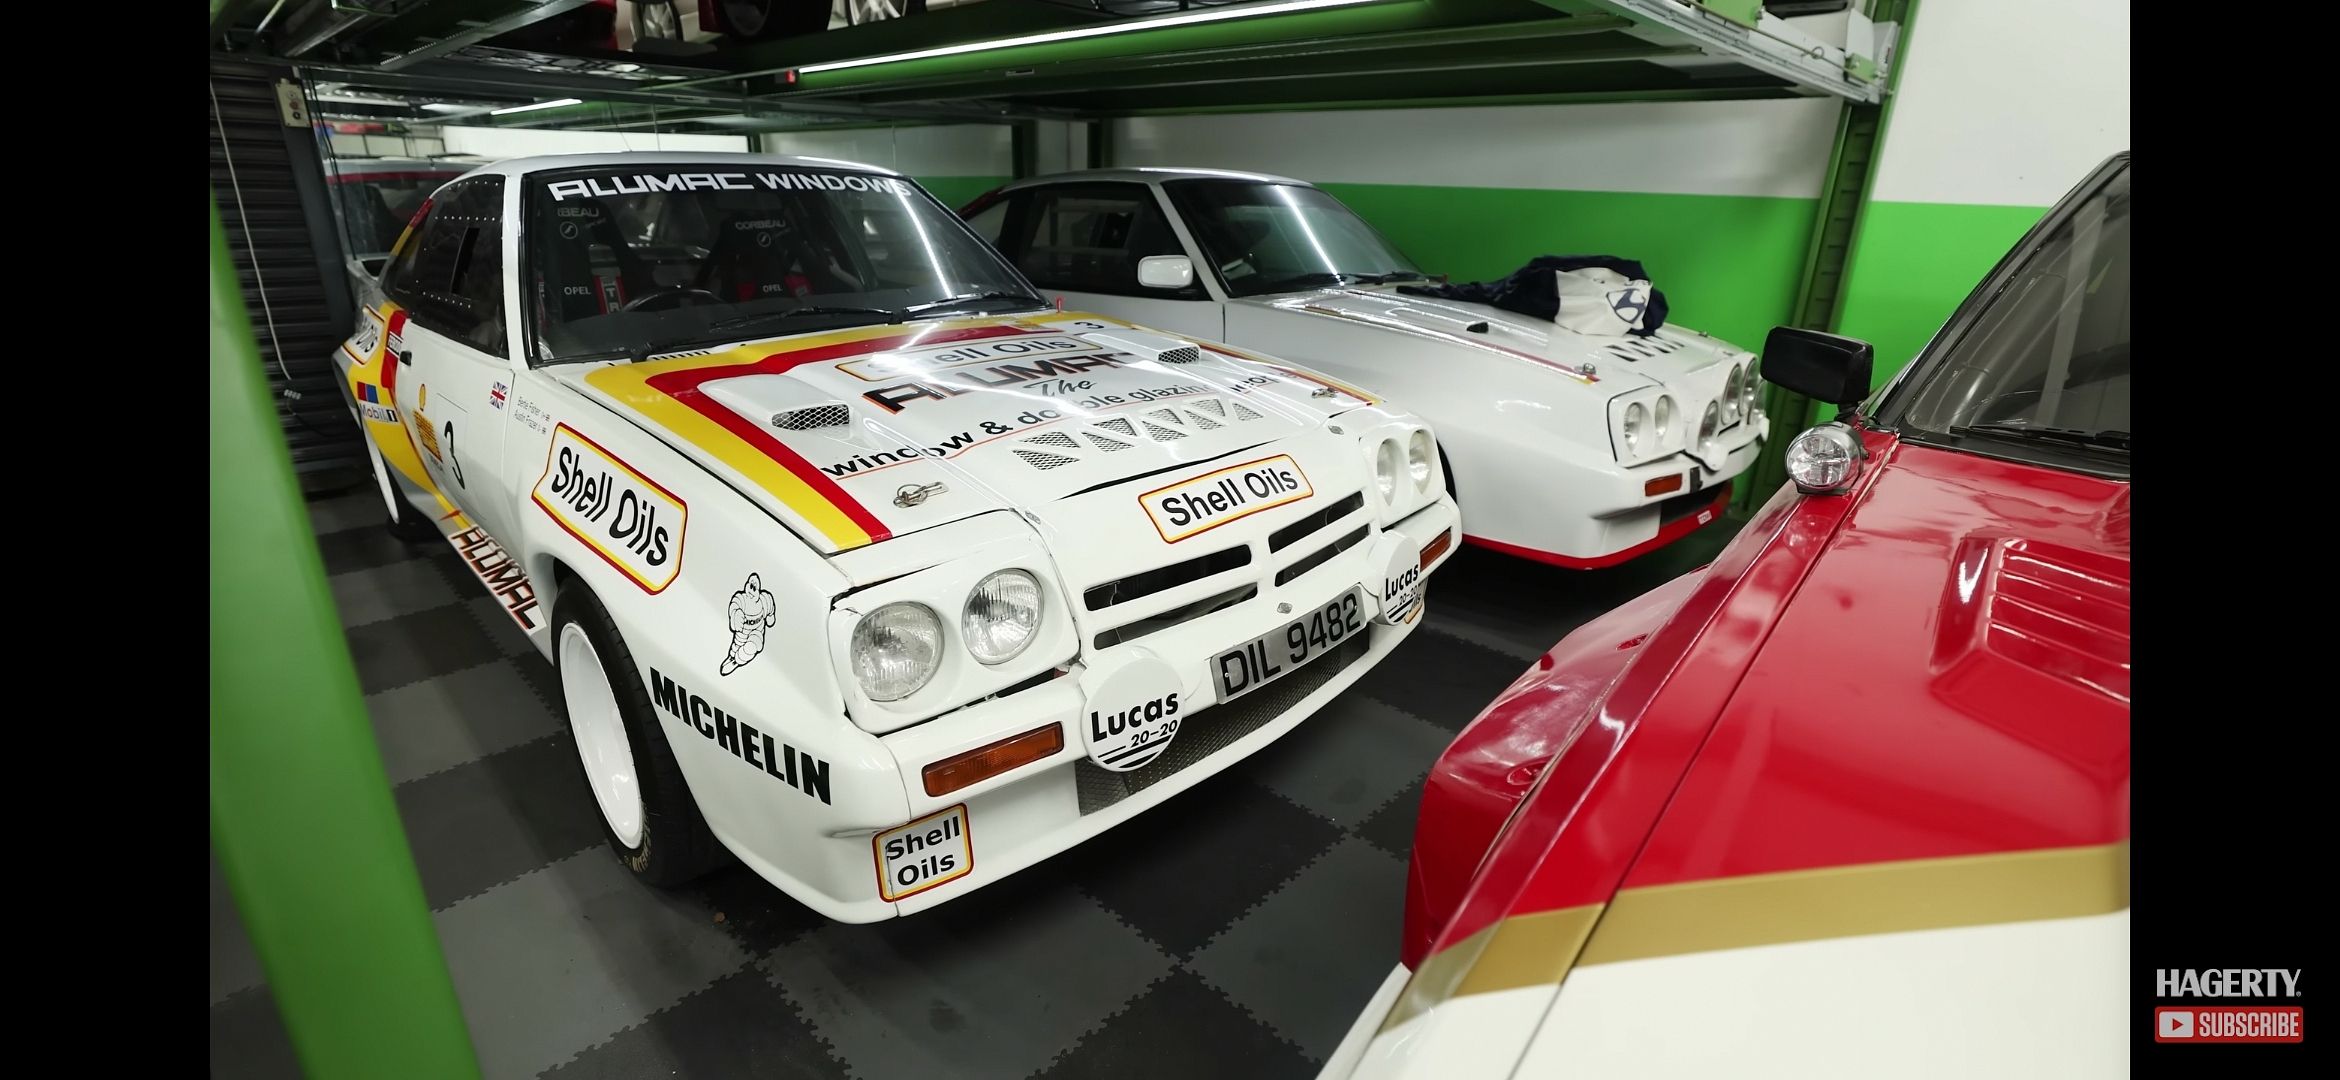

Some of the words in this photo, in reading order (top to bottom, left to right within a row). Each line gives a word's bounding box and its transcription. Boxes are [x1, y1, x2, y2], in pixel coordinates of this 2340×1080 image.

[547, 173, 755, 201] ALUMAC
[755, 173, 912, 197] WINDOWS
[563, 286, 591, 295] OPEL
[762, 284, 784, 293] OPEL
[1074, 321, 1105, 330] 3
[993, 340, 1077, 353] Oils
[1023, 378, 1097, 397] The
[979, 420, 1014, 436] &
[1128, 384, 1214, 402] glazin
[443, 420, 466, 490] 3
[551, 446, 613, 523] Shell
[608, 488, 669, 567] Oils
[1161, 477, 1246, 527] Shell
[1244, 468, 1298, 498] Oils
[1385, 564, 1419, 602] Lucas
[1219, 640, 1281, 698] DIL
[1286, 592, 1362, 664] 9482
[649, 665, 832, 806] MICHELIN
[1090, 692, 1179, 743] Lucas
[1130, 719, 1178, 749] 20-20
[885, 815, 961, 861] Shell
[897, 854, 955, 886] Oils
